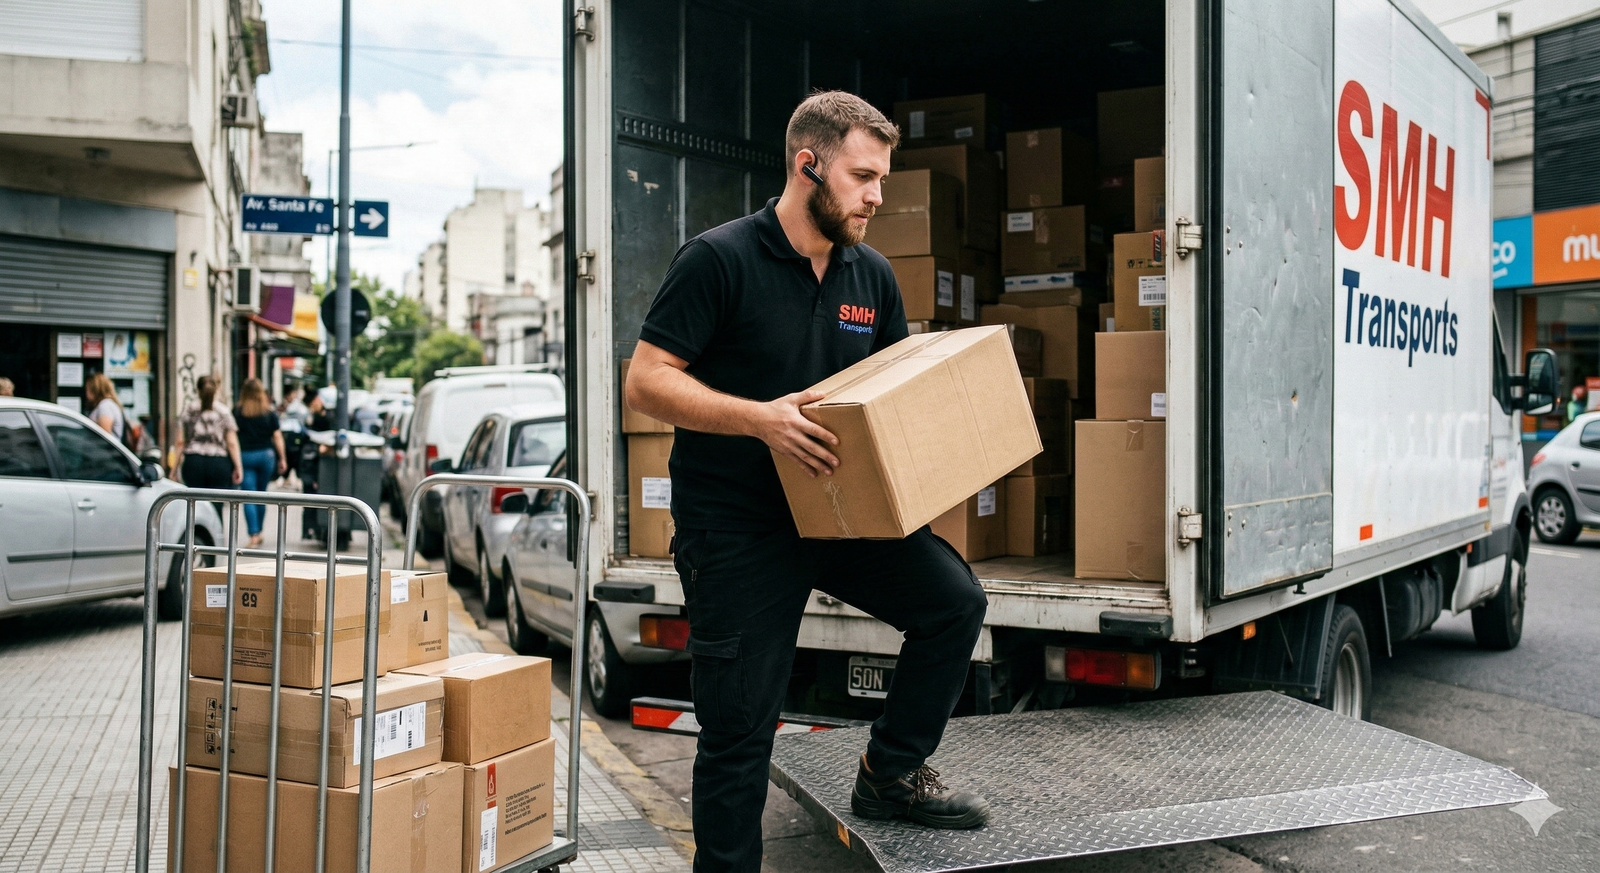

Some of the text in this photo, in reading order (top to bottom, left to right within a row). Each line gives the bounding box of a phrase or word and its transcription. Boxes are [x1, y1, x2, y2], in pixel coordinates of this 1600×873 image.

[1334, 80, 1455, 279] SMH
[245, 197, 325, 214] Av. Santa Fe
[838, 304, 876, 325] SMH
[1342, 267, 1459, 368] Transports
[838, 320, 874, 334] Transports
